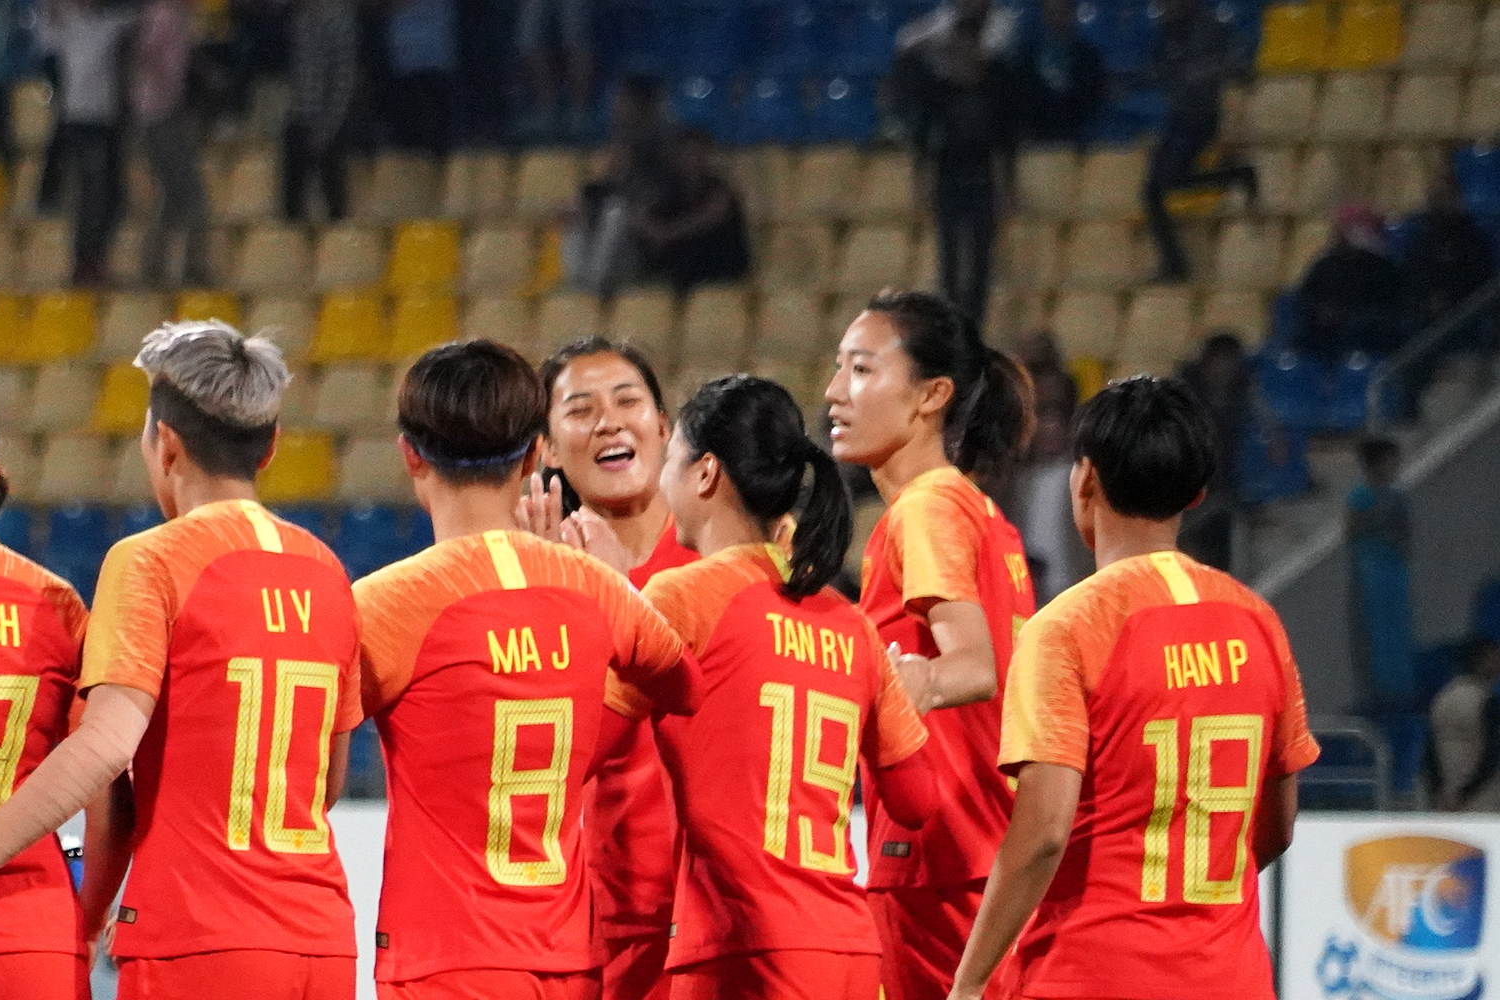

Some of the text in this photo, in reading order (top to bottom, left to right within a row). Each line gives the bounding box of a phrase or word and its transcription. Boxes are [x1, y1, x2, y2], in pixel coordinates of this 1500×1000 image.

[290, 589, 311, 634] Y
[487, 624, 570, 674] MA J
[766, 612, 854, 675] TAN RY
[1164, 639, 1249, 690] HAN P
[227, 657, 340, 854] 10
[486, 697, 574, 886] 8
[759, 681, 861, 875] 19
[1141, 714, 1264, 904] 18
